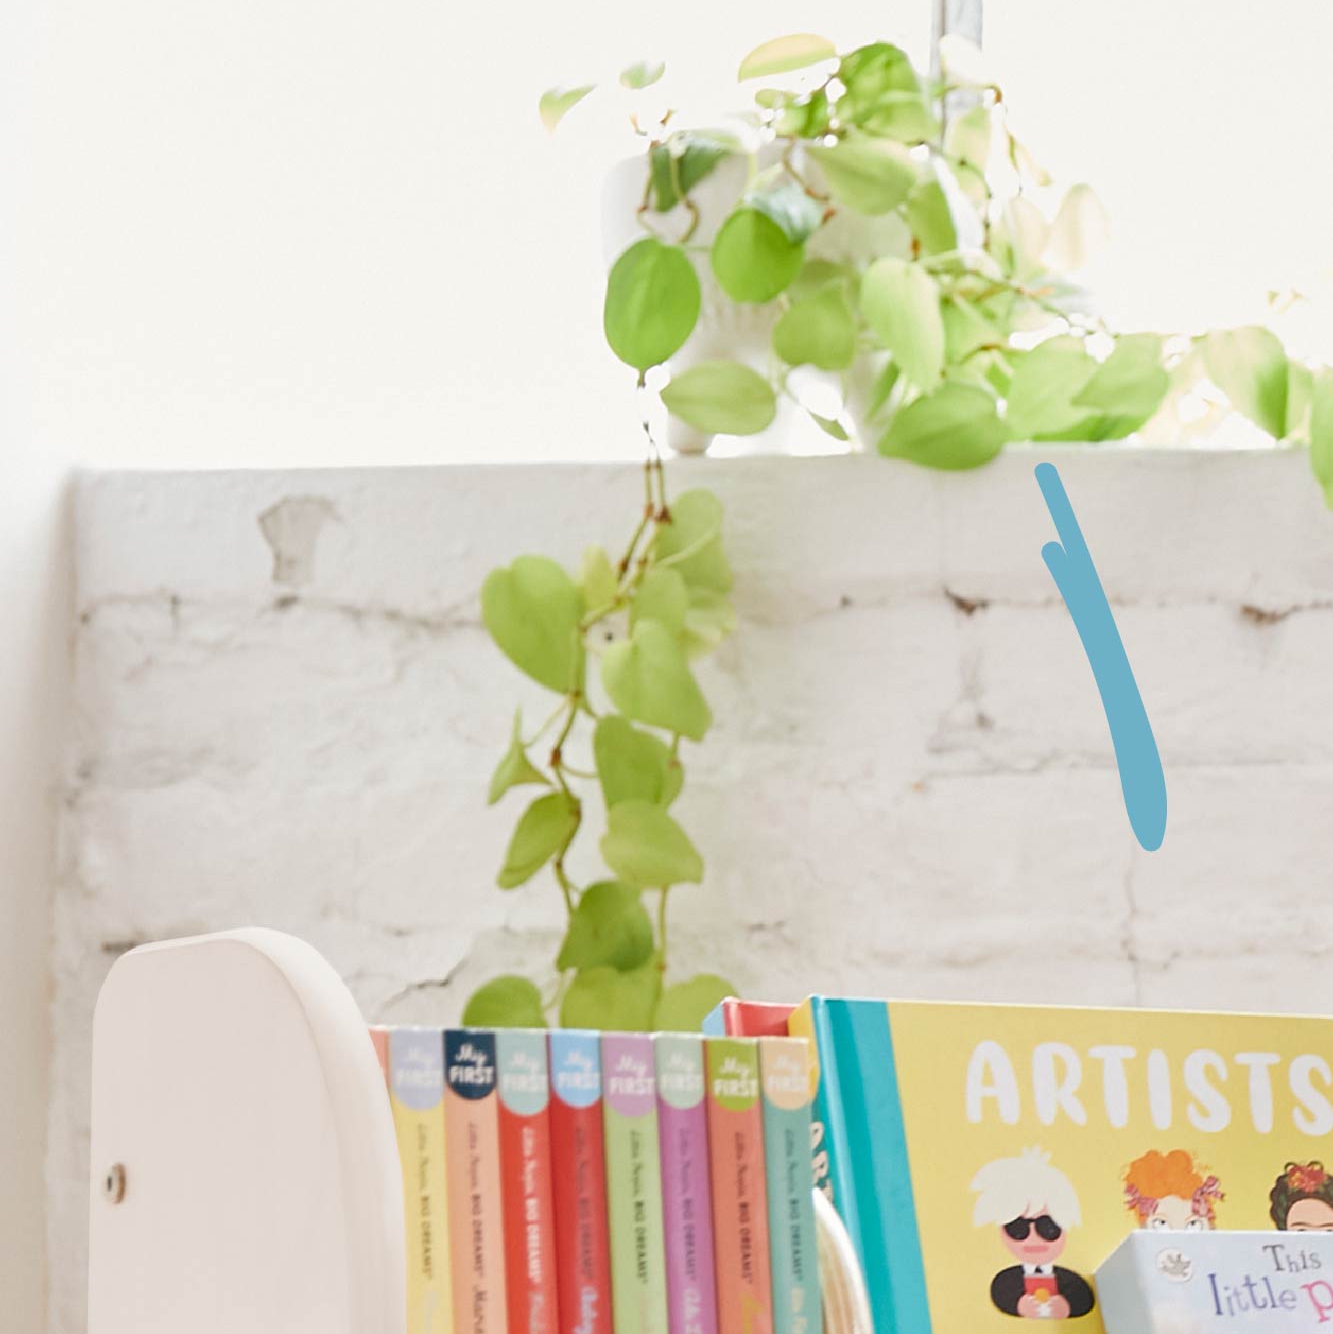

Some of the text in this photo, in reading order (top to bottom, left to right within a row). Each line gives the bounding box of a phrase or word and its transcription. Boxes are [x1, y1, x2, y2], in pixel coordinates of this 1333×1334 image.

[456, 1043, 487, 1066] My
[450, 1065, 494, 1085] FIRST
[616, 1055, 648, 1076] My
[609, 1077, 655, 1095] FIRST
[713, 1078, 759, 1097] FIRST
[1262, 1244, 1322, 1273] This
[1208, 1273, 1297, 1317] little
